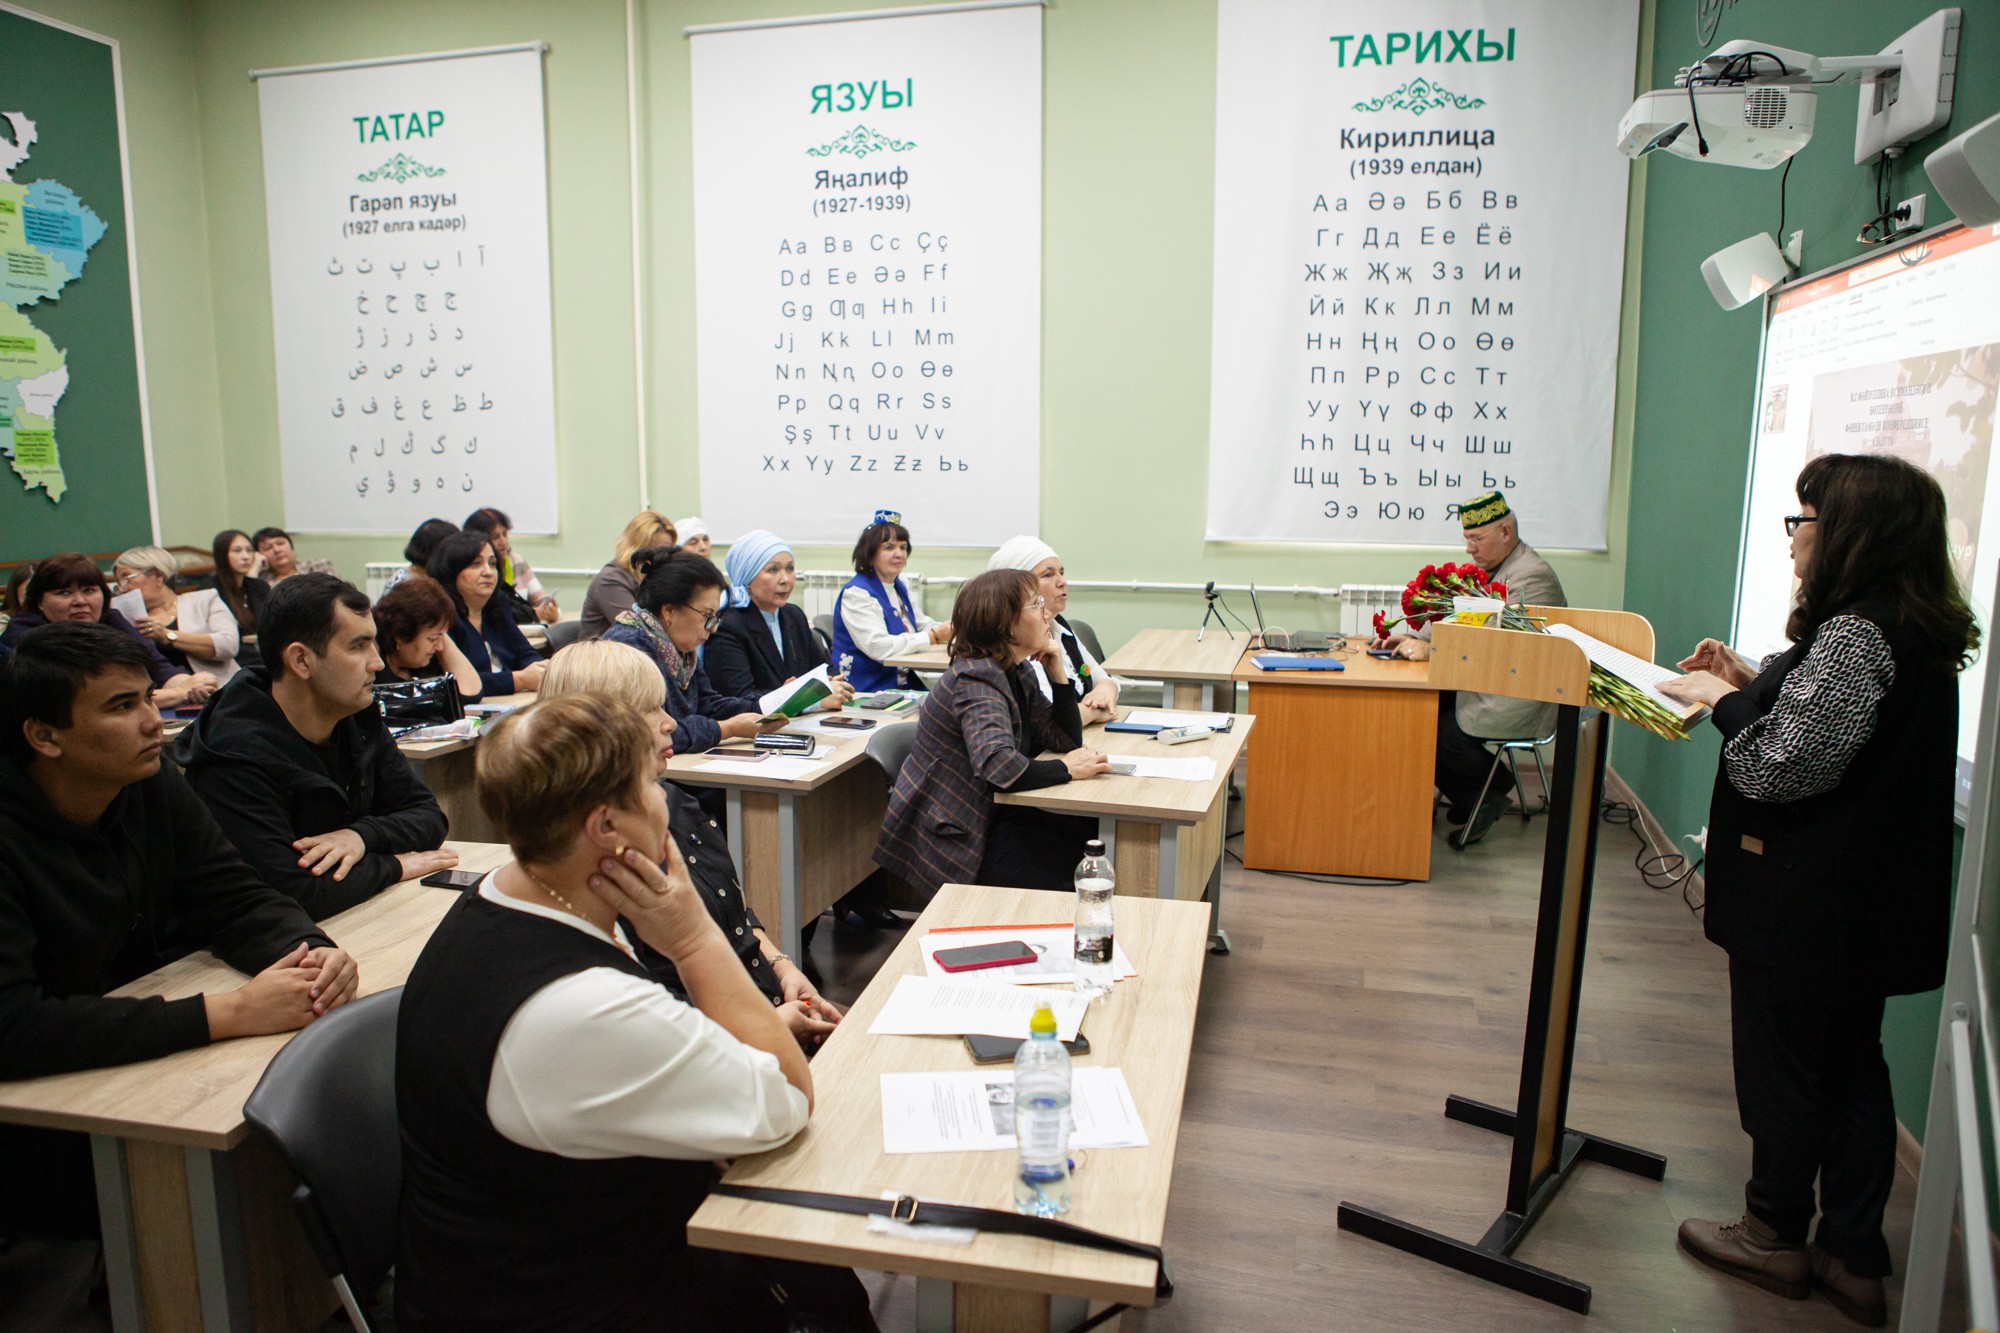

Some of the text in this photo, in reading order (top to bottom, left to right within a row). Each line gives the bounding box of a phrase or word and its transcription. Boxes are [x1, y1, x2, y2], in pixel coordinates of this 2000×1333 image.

[1329, 27, 1516, 68] ТАРИХЫ
[809, 77, 913, 114] ЯЗУЫ
[352, 109, 445, 144] ТАТАР
[1340, 127, 1495, 154] Кириллица
[814, 165, 908, 191] Яңалиф
[1350, 156, 1482, 180] (1939 елдан)
[349, 192, 457, 216] Гарәп язуы
[813, 194, 910, 218] (1927-1939)
[342, 214, 466, 238] (1927 елга кадәр)
